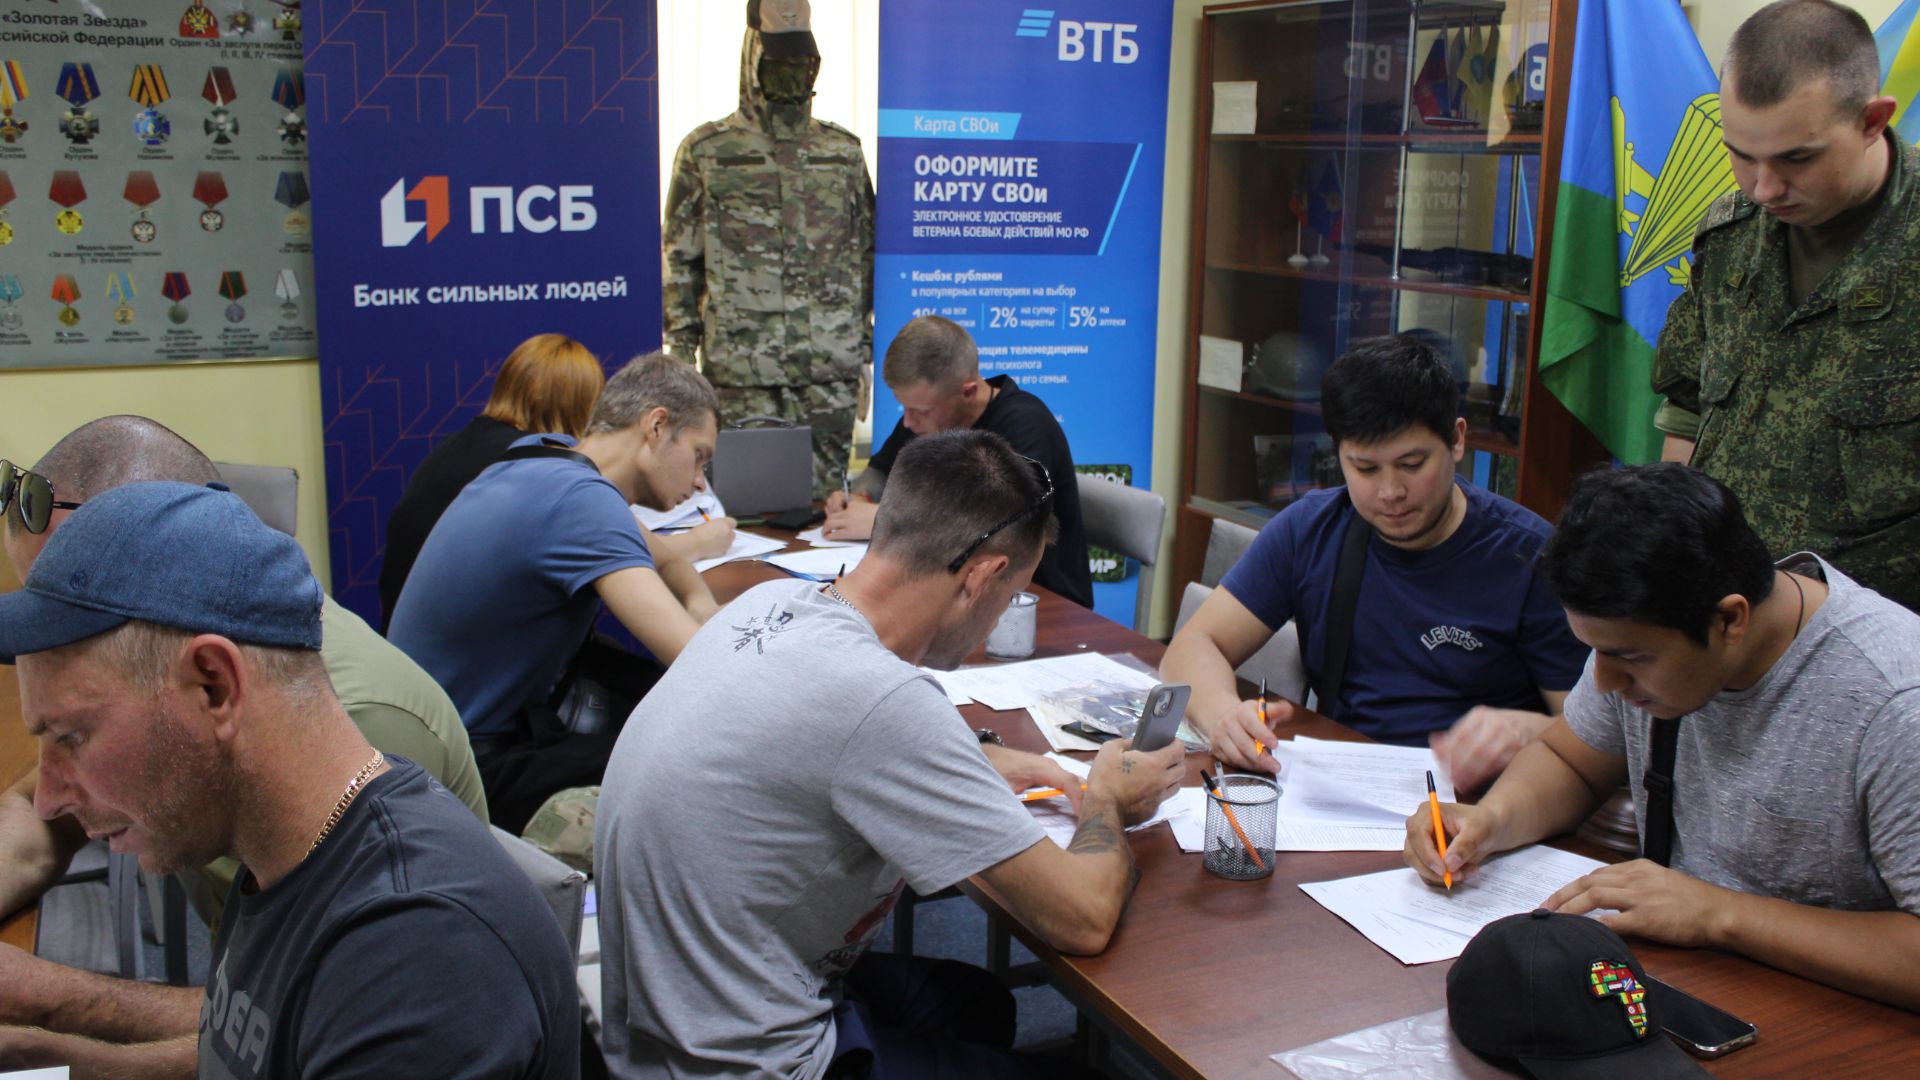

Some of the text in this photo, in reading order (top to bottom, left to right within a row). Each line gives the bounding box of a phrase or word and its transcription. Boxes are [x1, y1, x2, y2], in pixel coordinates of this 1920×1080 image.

[2, 11, 148, 29] «Золотая Звезда»
[0, 30, 164, 48] сийской Федерации
[1058, 20, 1139, 64] ВТБ
[914, 115, 999, 135] Карта СВОи
[914, 155, 1038, 178] ОФОРМИТЕ
[914, 181, 1048, 203] КАРТУ СВОи
[470, 184, 597, 234] ПСБ
[912, 210, 1062, 225] ЭЛЕКТРОННОЕ УДОСТОВЕРЕНИЕ
[912, 224, 1089, 239] ВЕТЕРАНА БОЕВЫХ ДЕЙСТВИЙ МО РФ
[911, 269, 1003, 284] Кешбэк рублями
[353, 276, 627, 307] Банк сильных людей
[911, 284, 1076, 299] в популярных категориях на выбор
[989, 306, 1018, 328] 2%
[1069, 306, 1097, 328] 5%
[1010, 345, 1089, 357] телемедицины
[995, 361, 1042, 371] психолога
[1089, 559, 1117, 573] ИР
